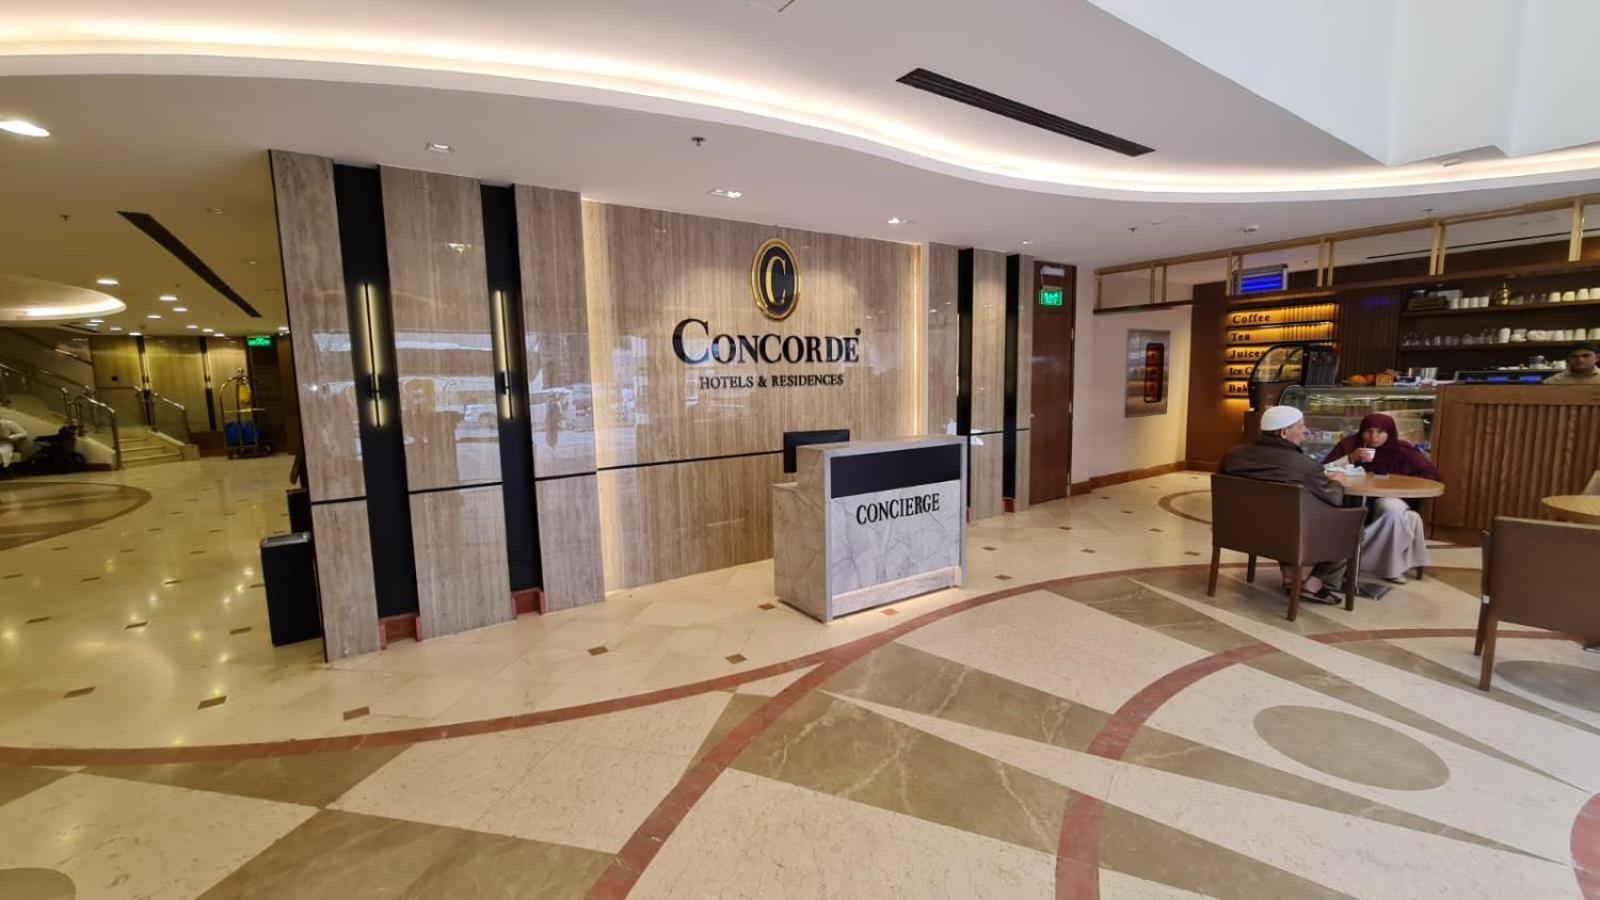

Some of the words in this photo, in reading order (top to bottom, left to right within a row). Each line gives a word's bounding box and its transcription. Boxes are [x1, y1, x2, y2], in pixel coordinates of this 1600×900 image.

[766, 255, 786, 306] C
[1232, 314, 1270, 324] Coffee
[672, 318, 860, 364] CONCORDE
[1231, 332, 1250, 341] Tea
[1230, 367, 1243, 375] Ice
[700, 375, 753, 390] HOTELS
[757, 375, 767, 388] &
[771, 373, 844, 388] RESIDENCES
[1229, 384, 1248, 393] Bak
[856, 493, 940, 525] CONCIERGE
